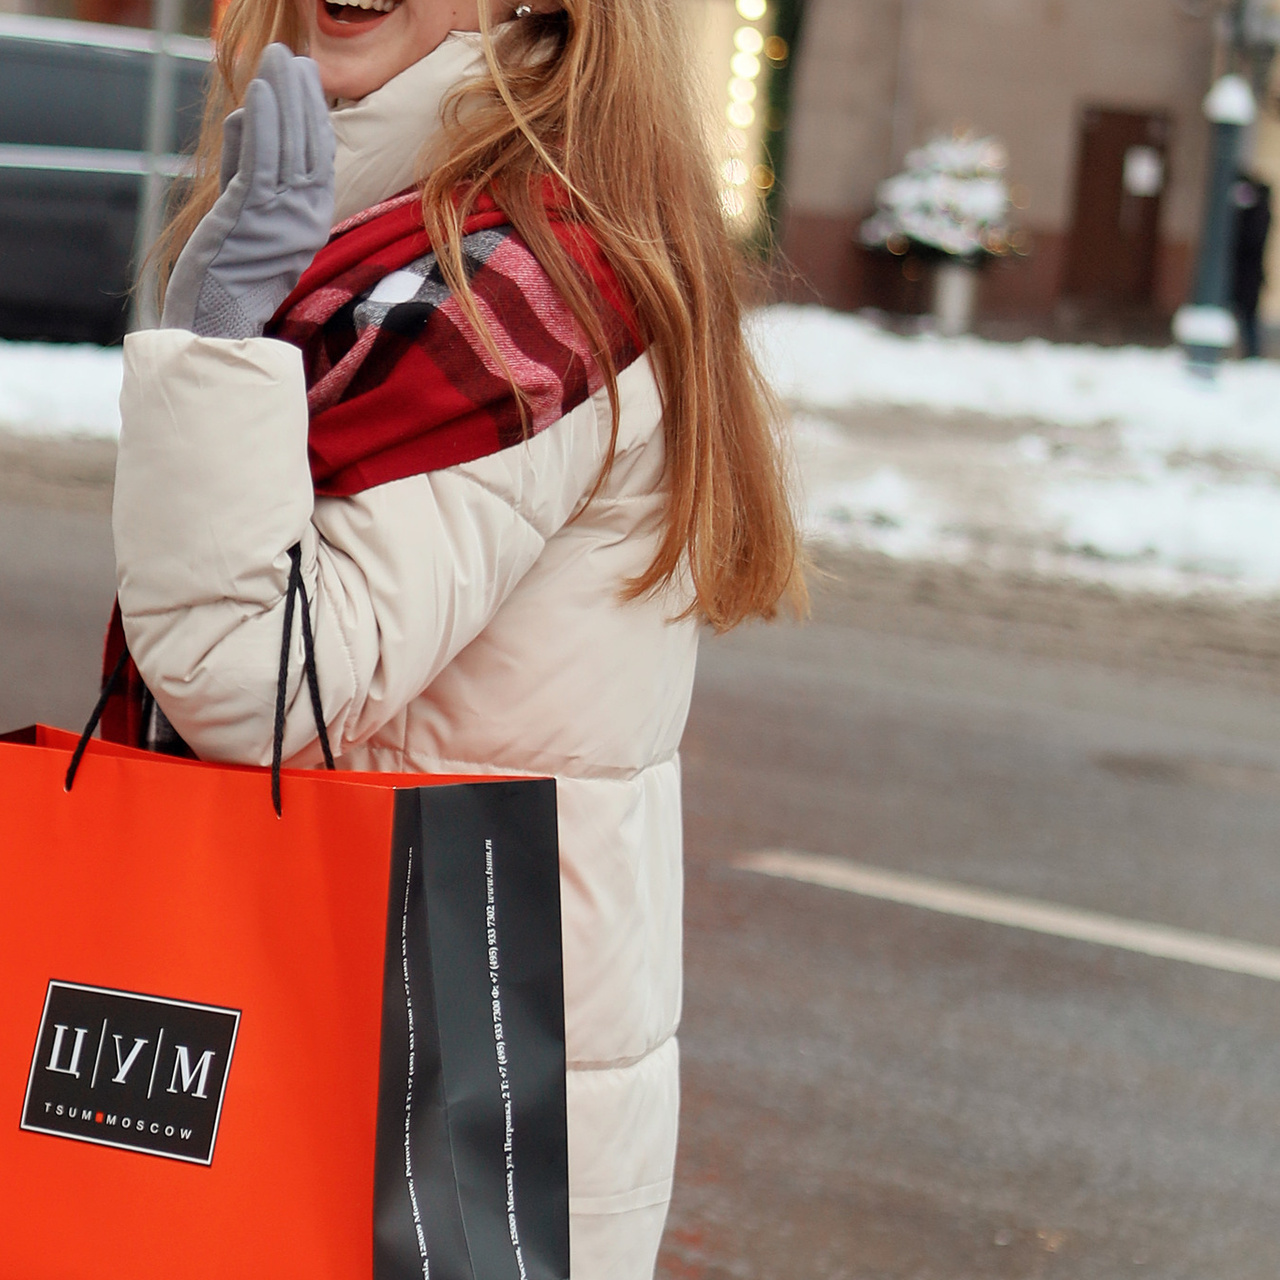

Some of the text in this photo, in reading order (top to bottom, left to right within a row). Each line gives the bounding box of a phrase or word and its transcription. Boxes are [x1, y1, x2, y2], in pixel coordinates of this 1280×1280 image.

[484, 839, 495, 904] www.tsum.ru
[485, 904, 496, 928] 7302
[487, 928, 497, 946] 933
[488, 946, 500, 970] (495)
[489, 971, 499, 984] +7
[492, 999, 502, 1023] 7300
[494, 1022, 504, 1041] 933
[45, 1018, 216, 1099] ЦУМ
[496, 1041, 508, 1065] (495)
[498, 1066, 507, 1079] +7
[501, 1091, 511, 1099] 2
[43, 1101, 192, 1141] TSUM MOSCOW
[508, 1212, 520, 1246] 125009
